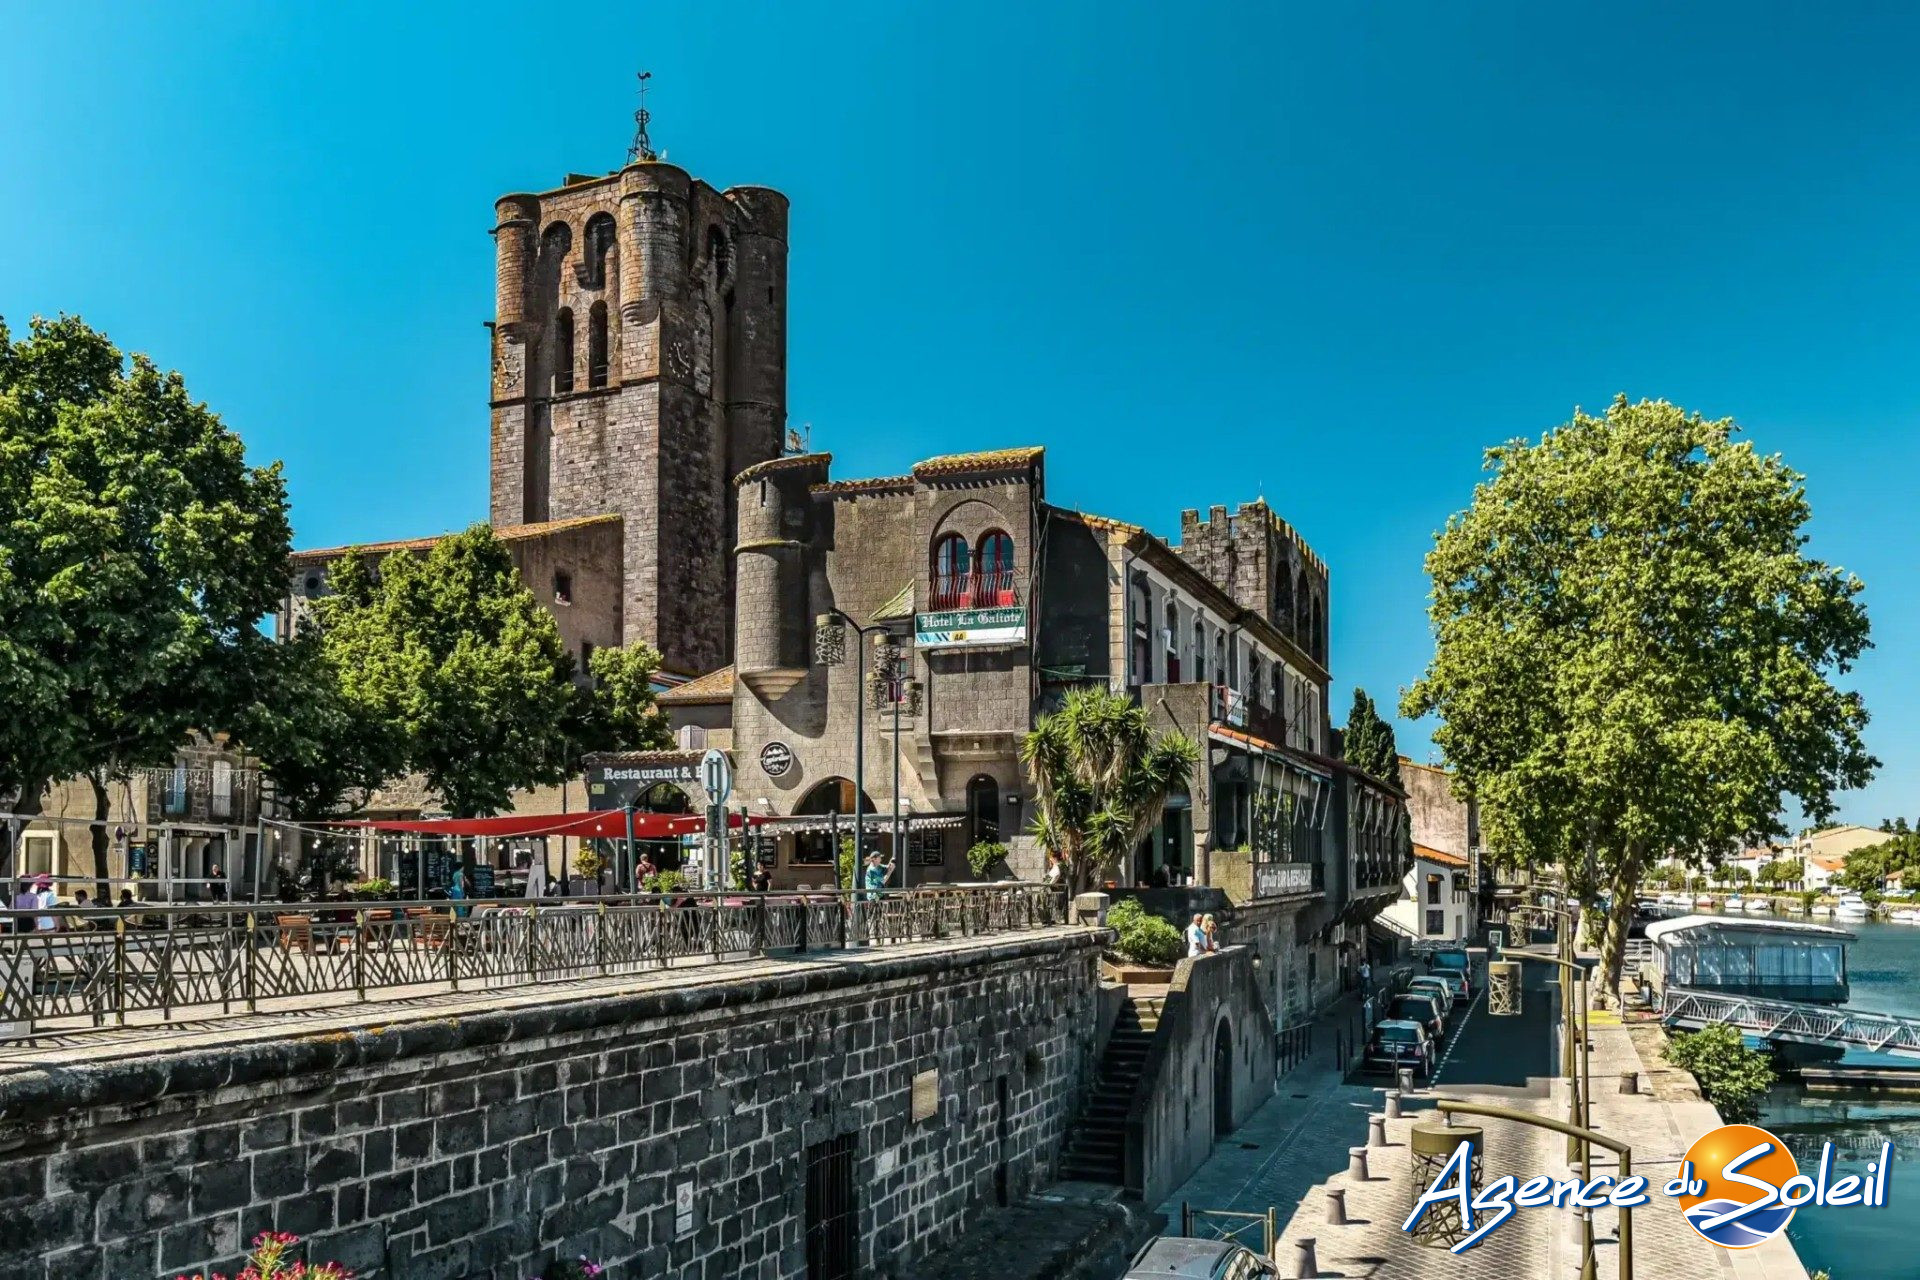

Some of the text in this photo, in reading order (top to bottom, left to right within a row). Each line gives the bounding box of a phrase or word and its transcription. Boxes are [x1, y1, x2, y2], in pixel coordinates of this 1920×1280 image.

[922, 612, 1021, 629] Hotel La Galiote
[603, 767, 679, 780] Restaurant
[681, 766, 692, 779] &
